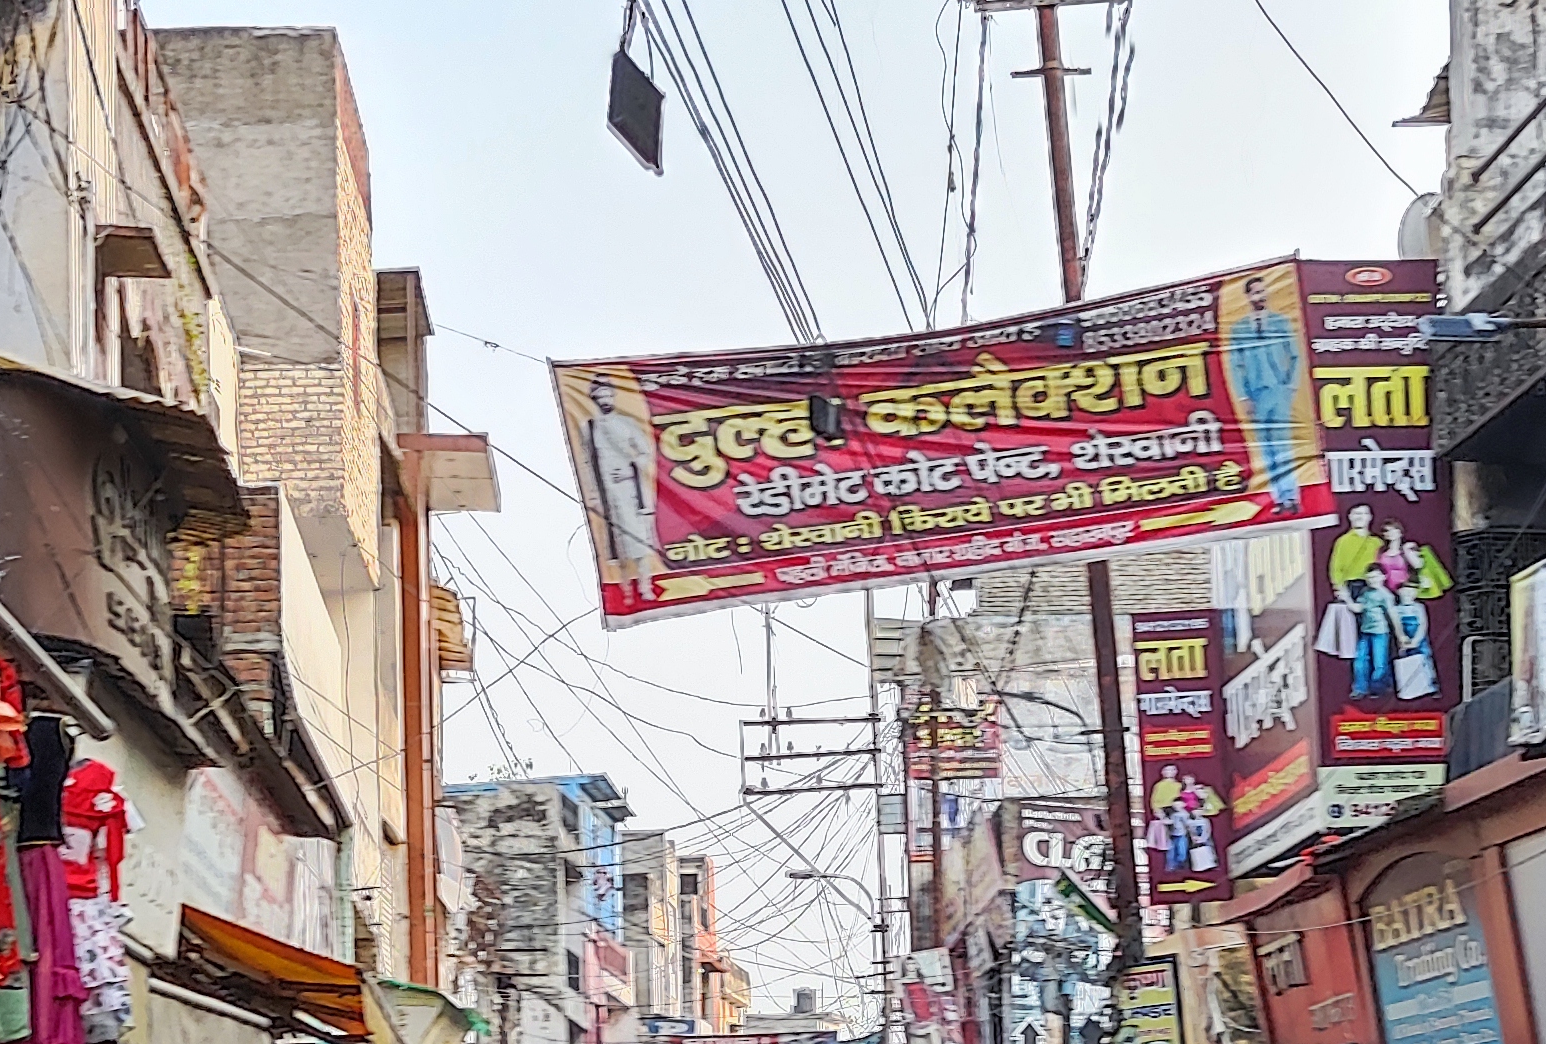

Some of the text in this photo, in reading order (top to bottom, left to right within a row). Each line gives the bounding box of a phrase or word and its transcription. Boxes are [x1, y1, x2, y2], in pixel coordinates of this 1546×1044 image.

[653, 341, 1211, 490] दुल्ह कलैक्शन
[1312, 364, 1432, 427] लता
[732, 462, 870, 517] रेडीमेट
[870, 450, 964, 497] कोट
[1070, 409, 1225, 471] शेरवानी
[664, 533, 732, 563] नोट
[759, 511, 886, 552] शेरवानी
[998, 494, 1049, 519] पर
[1050, 482, 1095, 512] भी
[1099, 465, 1209, 508] मिलती
[1213, 461, 1247, 493] है
[1133, 637, 1209, 681] लता
[1368, 879, 1468, 951] BATRA
